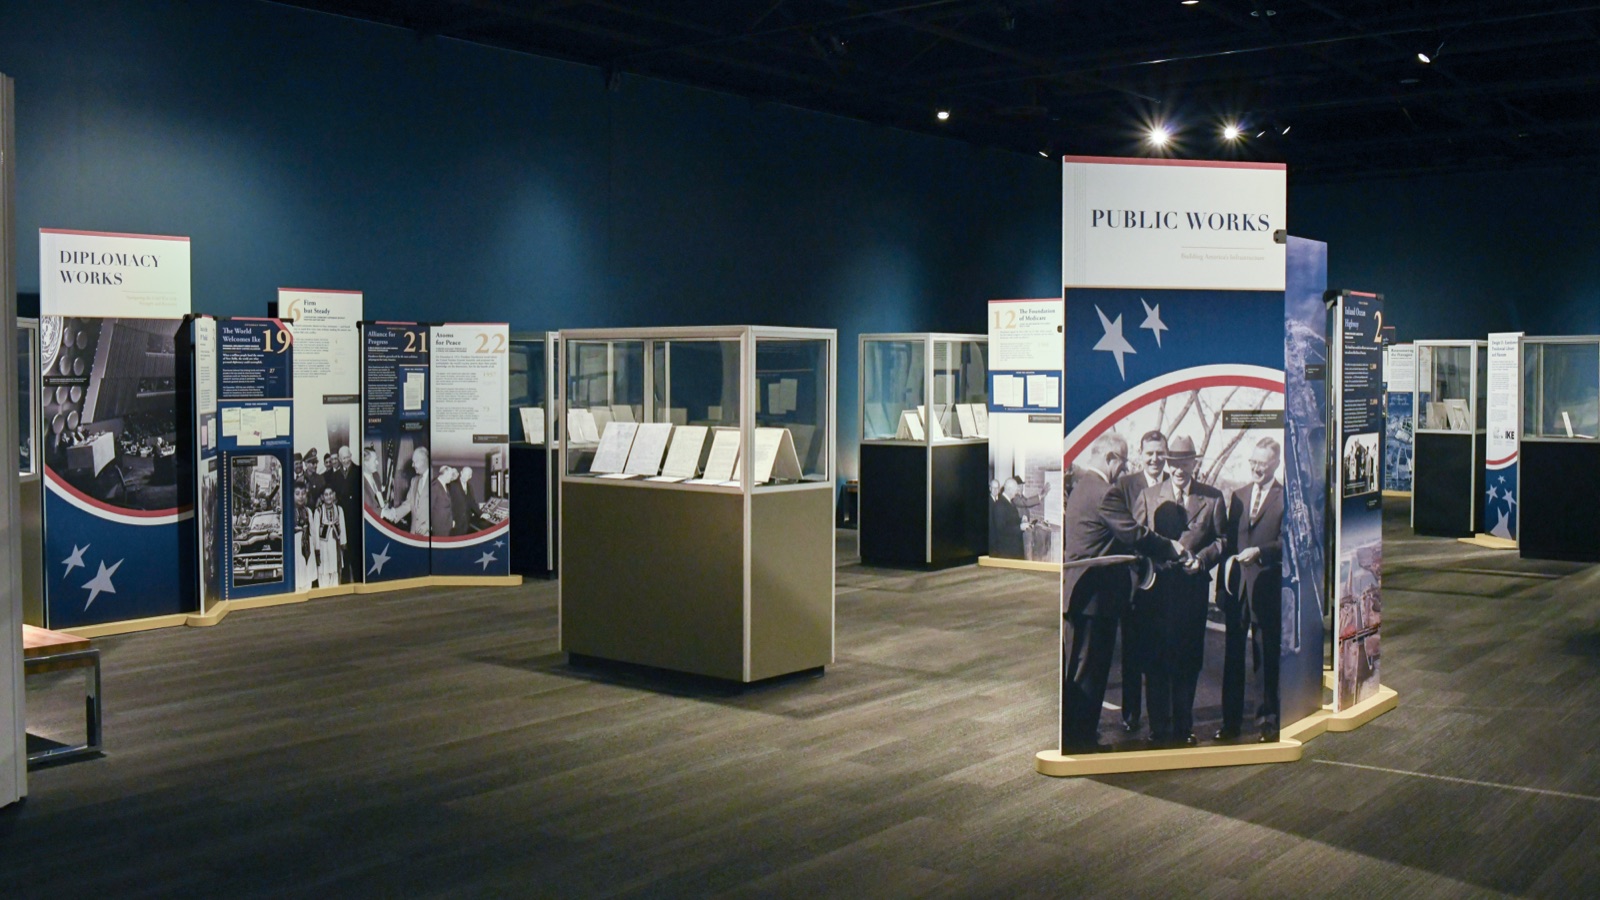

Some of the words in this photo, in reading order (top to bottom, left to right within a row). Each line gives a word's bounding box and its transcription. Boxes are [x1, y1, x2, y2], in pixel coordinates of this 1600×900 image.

[1090, 209, 1178, 230] PUBLIC
[1185, 212, 1270, 232] WORKS
[60, 250, 160, 268] DIPLOMACY
[1181, 252, 1204, 261] Building
[60, 270, 123, 286] WORKS
[994, 310, 1016, 330] 12
[262, 328, 290, 354] 19
[404, 332, 428, 352] 21
[475, 333, 506, 354] 22
